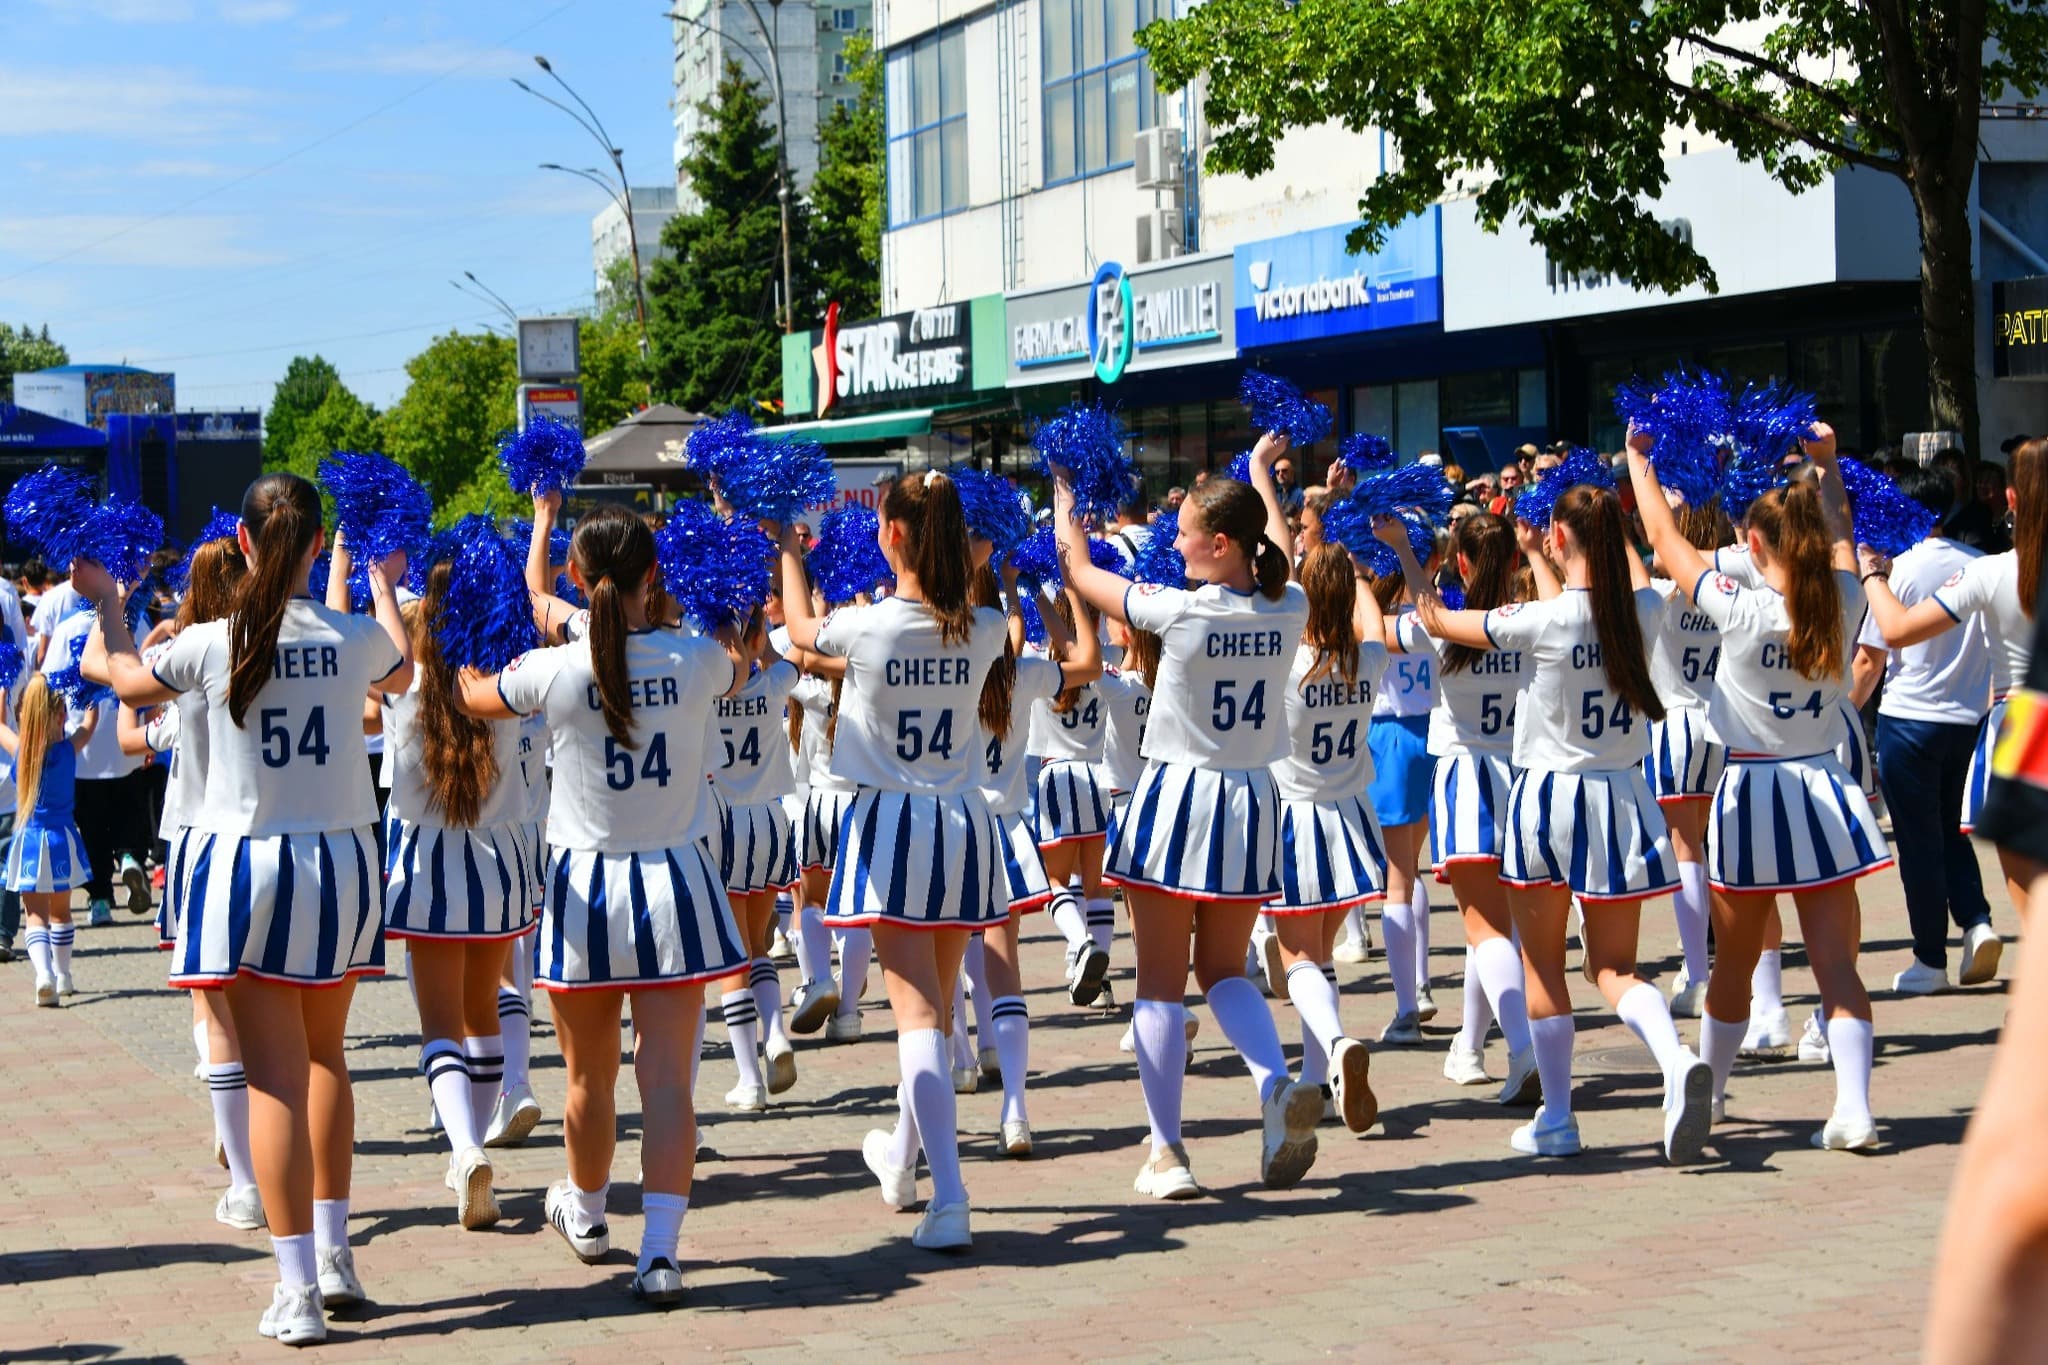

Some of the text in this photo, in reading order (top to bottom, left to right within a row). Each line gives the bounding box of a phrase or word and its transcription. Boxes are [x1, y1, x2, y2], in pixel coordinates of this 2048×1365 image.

[1013, 314, 1090, 359] FARMACIA
[1133, 281, 1220, 342] FAMILIEI
[835, 322, 901, 398] STAR
[1207, 631, 1282, 658] CHEER
[1682, 646, 1720, 683] 54
[587, 676, 679, 711] CEER
[886, 658, 970, 687] CHEER
[1305, 680, 1371, 708] CHEER
[1398, 659, 1431, 694] 54
[713, 696, 767, 717] HEER
[1213, 680, 1266, 731] 54
[1582, 690, 1633, 739] 54
[261, 706, 330, 768] 54
[896, 708, 953, 762] 54
[1311, 719, 1358, 764] 54
[605, 731, 671, 791] 54
